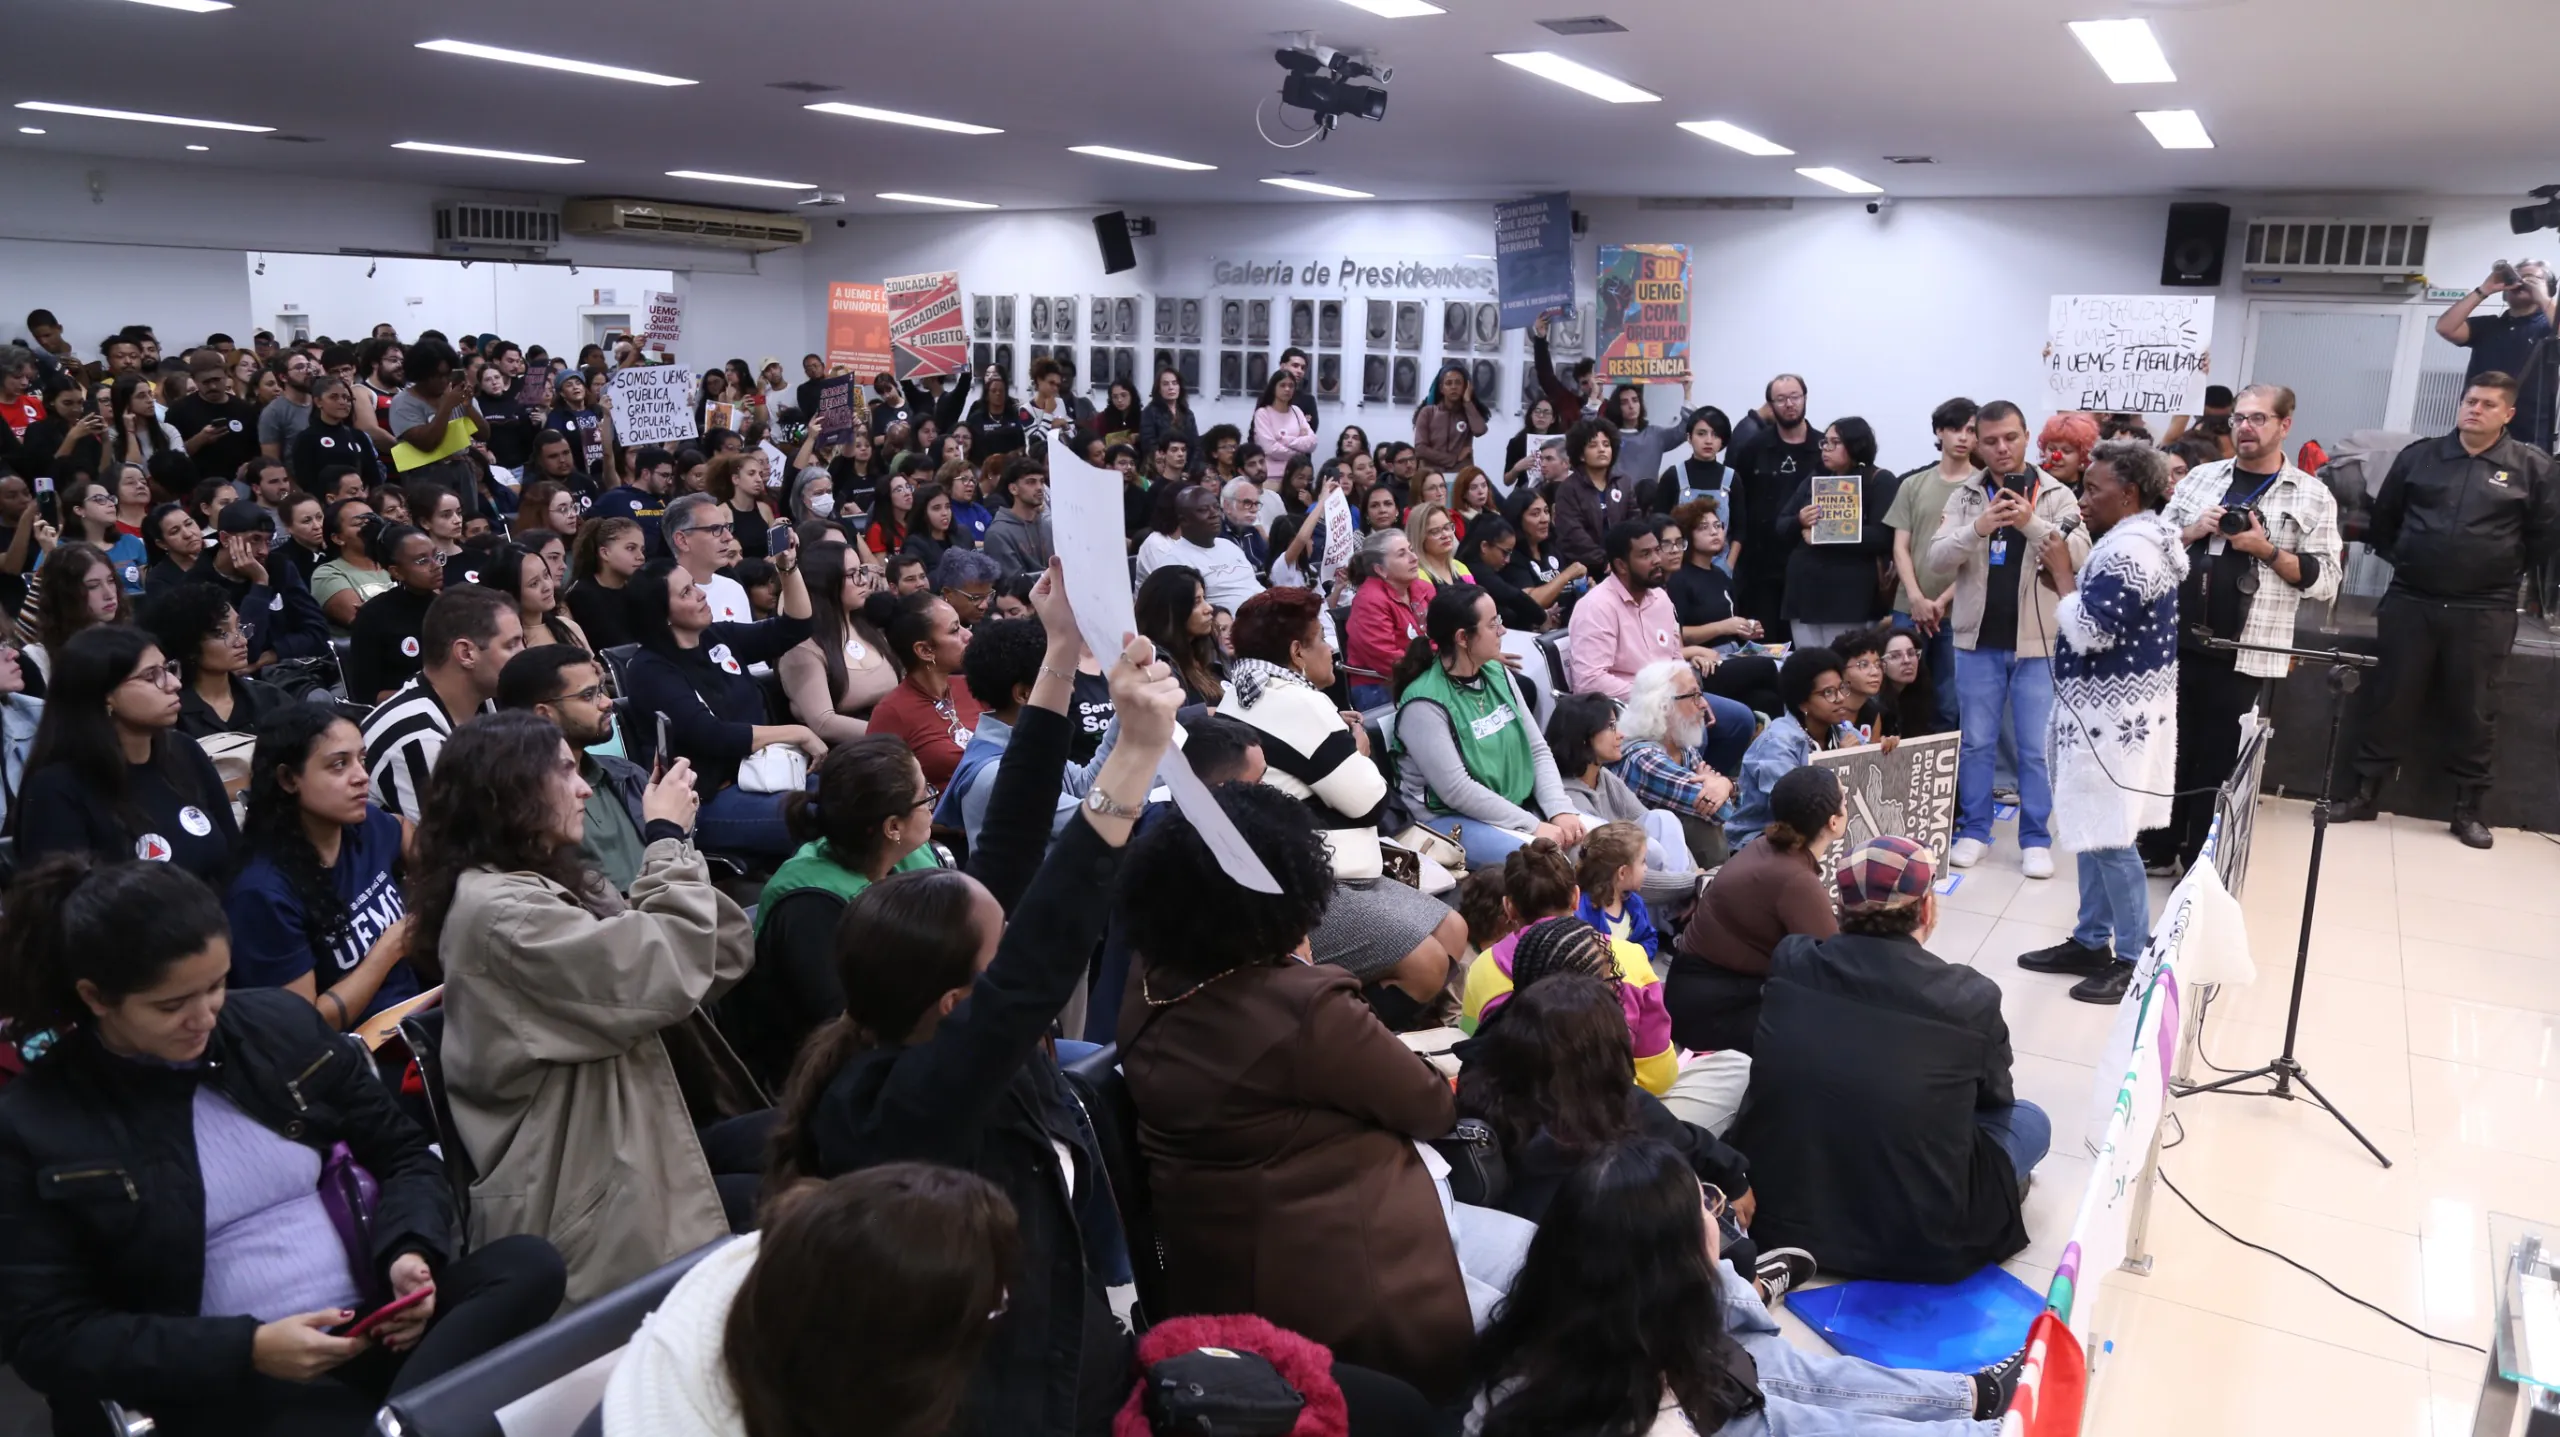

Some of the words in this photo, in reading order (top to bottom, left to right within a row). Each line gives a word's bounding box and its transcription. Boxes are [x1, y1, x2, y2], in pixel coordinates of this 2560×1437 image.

[1213, 260, 1293, 285] Galeria
[1301, 260, 1331, 285] de
[1339, 259, 1495, 288] Presidentes
[1644, 260, 1679, 279] SOU
[835, 287, 842, 297] A
[844, 288, 871, 299] UEMG
[886, 276, 937, 293] EDUCAÇÃO
[1638, 283, 1682, 300] UEMG
[649, 305, 681, 317] UEMG:
[651, 315, 675, 324] QUEM
[890, 295, 960, 338] MERCADORIA.
[1644, 304, 1678, 322] COM
[920, 330, 963, 346] DIREITO
[1626, 325, 1687, 341] ORGULHO
[2074, 328, 2107, 347] UMA
[1648, 344, 1659, 357] E
[2052, 354, 2060, 371] A
[2067, 351, 2115, 373] UEMG
[616, 370, 657, 388] SOMOS
[2050, 373, 2077, 394] QUE
[2080, 391, 2108, 411] EM
[629, 415, 676, 429] POPULAR,
[587, 444, 603, 453] UEM
[1817, 496, 1853, 504] MINAS
[1838, 765, 1850, 777] E
[1907, 752, 1923, 812] CRUZA
[1917, 749, 1935, 841] EDUCAÇÃO
[1906, 819, 1917, 829] O
